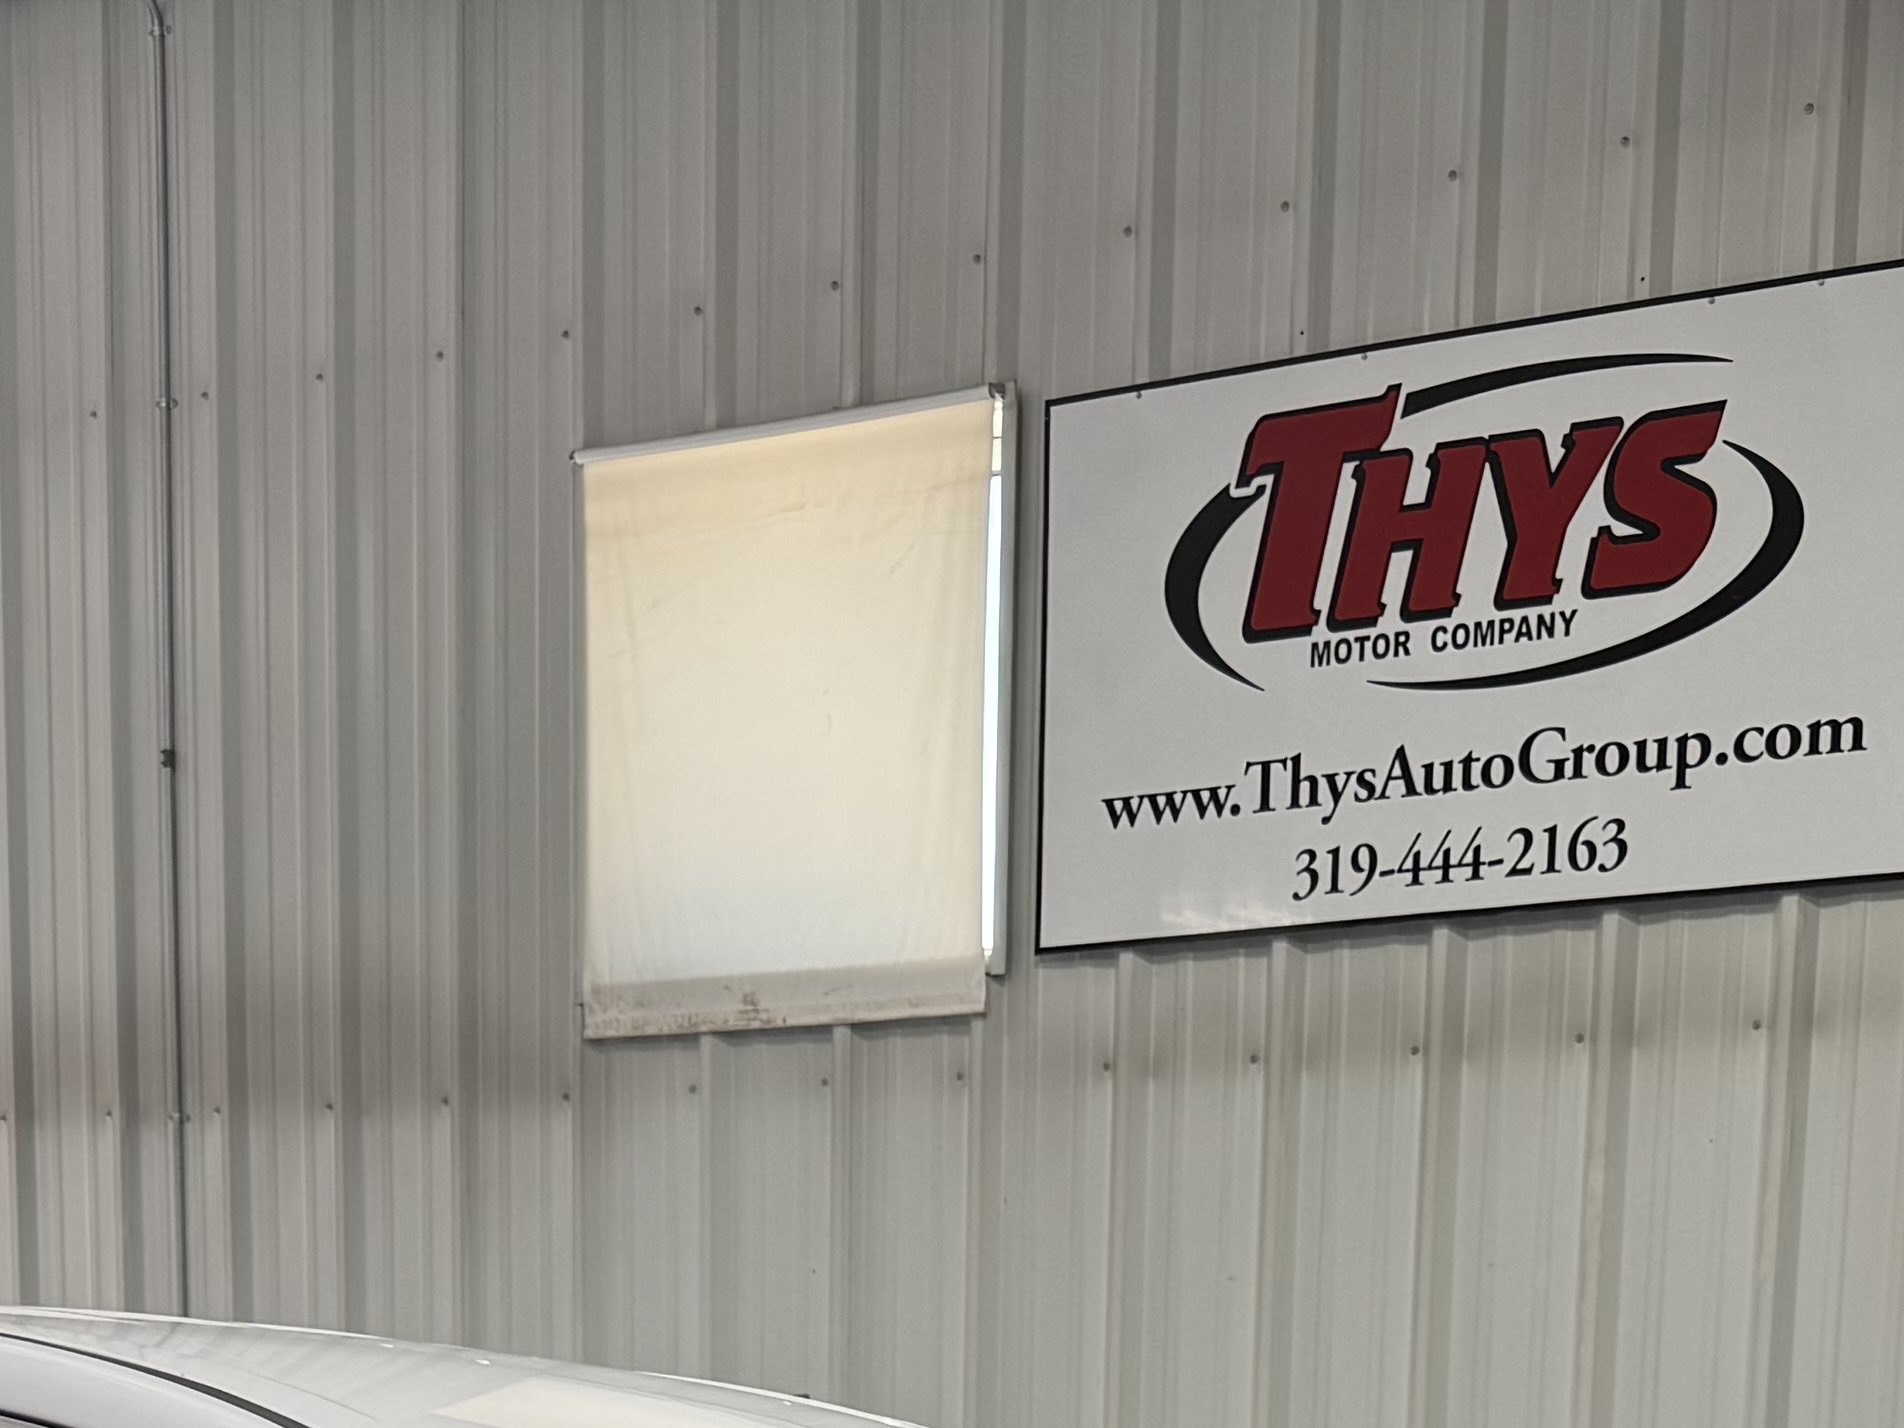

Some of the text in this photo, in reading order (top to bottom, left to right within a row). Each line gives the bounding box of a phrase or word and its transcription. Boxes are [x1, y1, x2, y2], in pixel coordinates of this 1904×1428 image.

[1235, 383, 1728, 644] THYS
[1310, 608, 1578, 668] MOTOR COMPANY
[1101, 717, 1867, 830] www.ThysAutoGroup.com
[1293, 816, 1628, 901] 319-444-2163
